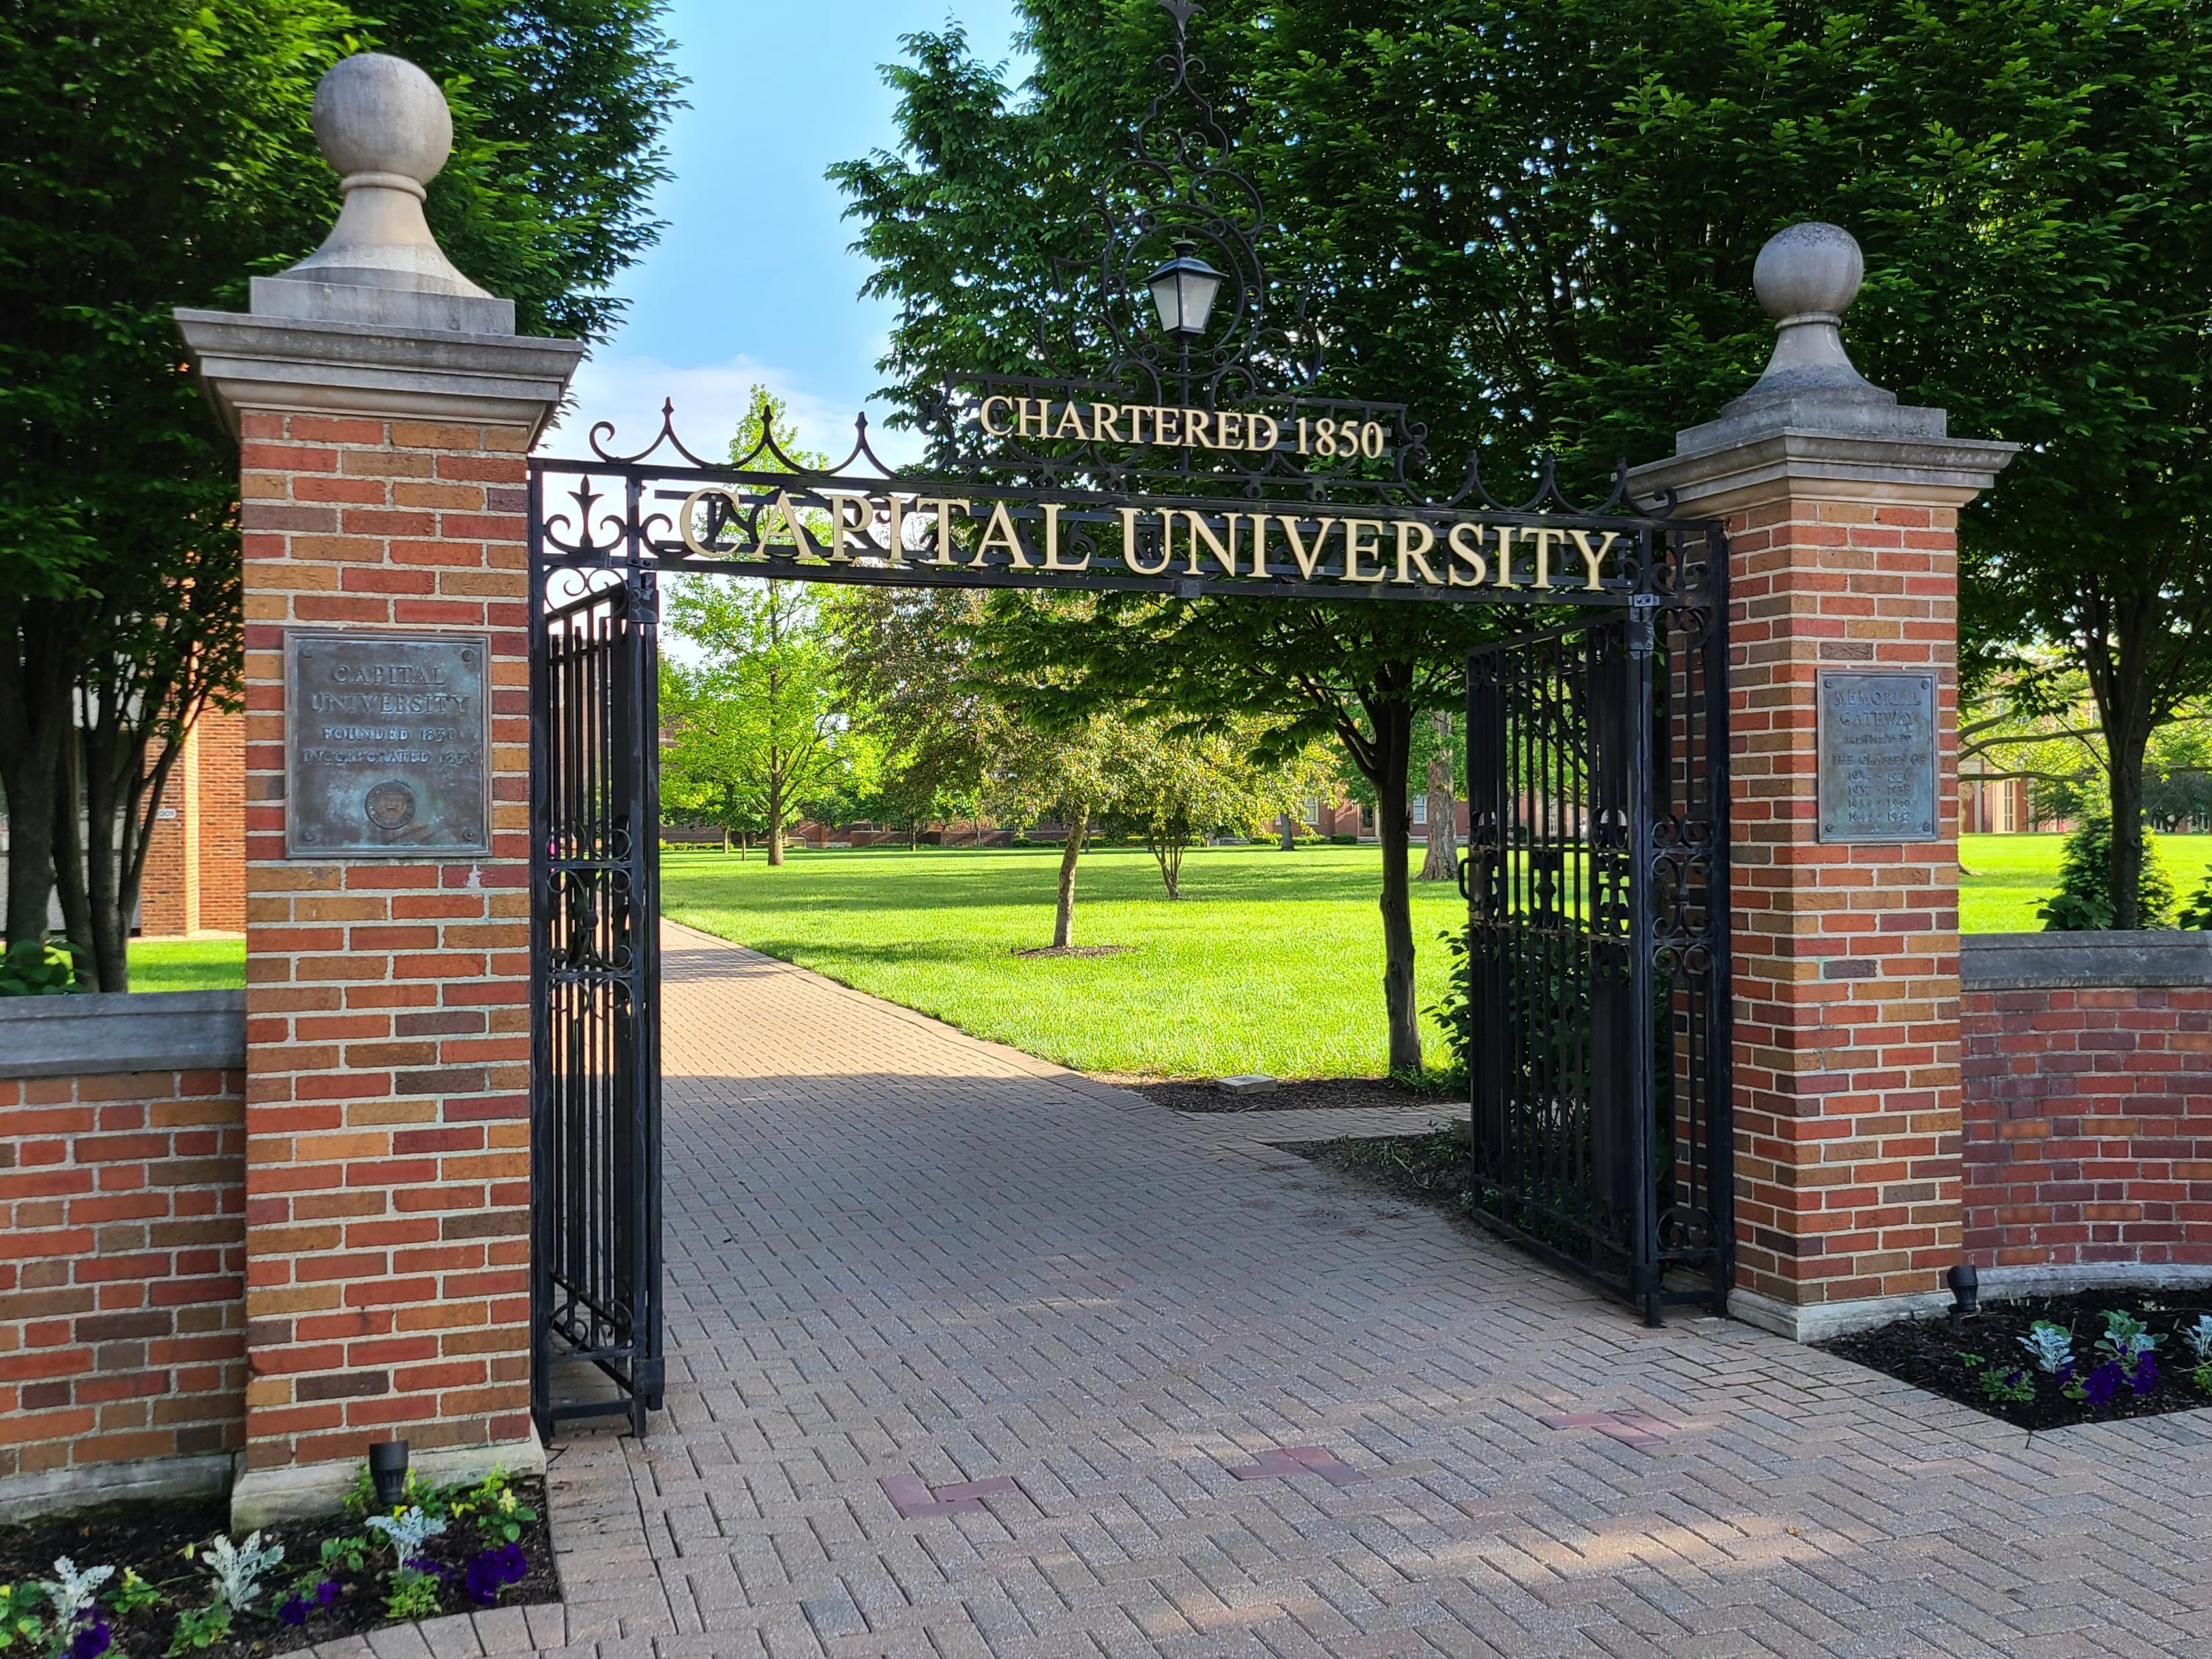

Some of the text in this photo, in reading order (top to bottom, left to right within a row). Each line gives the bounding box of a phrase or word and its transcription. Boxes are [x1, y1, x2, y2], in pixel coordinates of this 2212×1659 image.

[980, 395, 1385, 459] CHARTERED 1850
[679, 487, 1620, 591] CAPITAL UNIVERSITY
[333, 665, 446, 685] CAPITAL
[310, 692, 470, 714] UNIVERSITY
[1834, 690, 1922, 706] MEMORIAL
[1840, 709, 1914, 726] GATEWAY
[324, 727, 409, 741] FOUNDED
[302, 748, 431, 765] INCORPORATED
[1832, 754, 1852, 765] THE
[1910, 754, 1925, 766] OF
